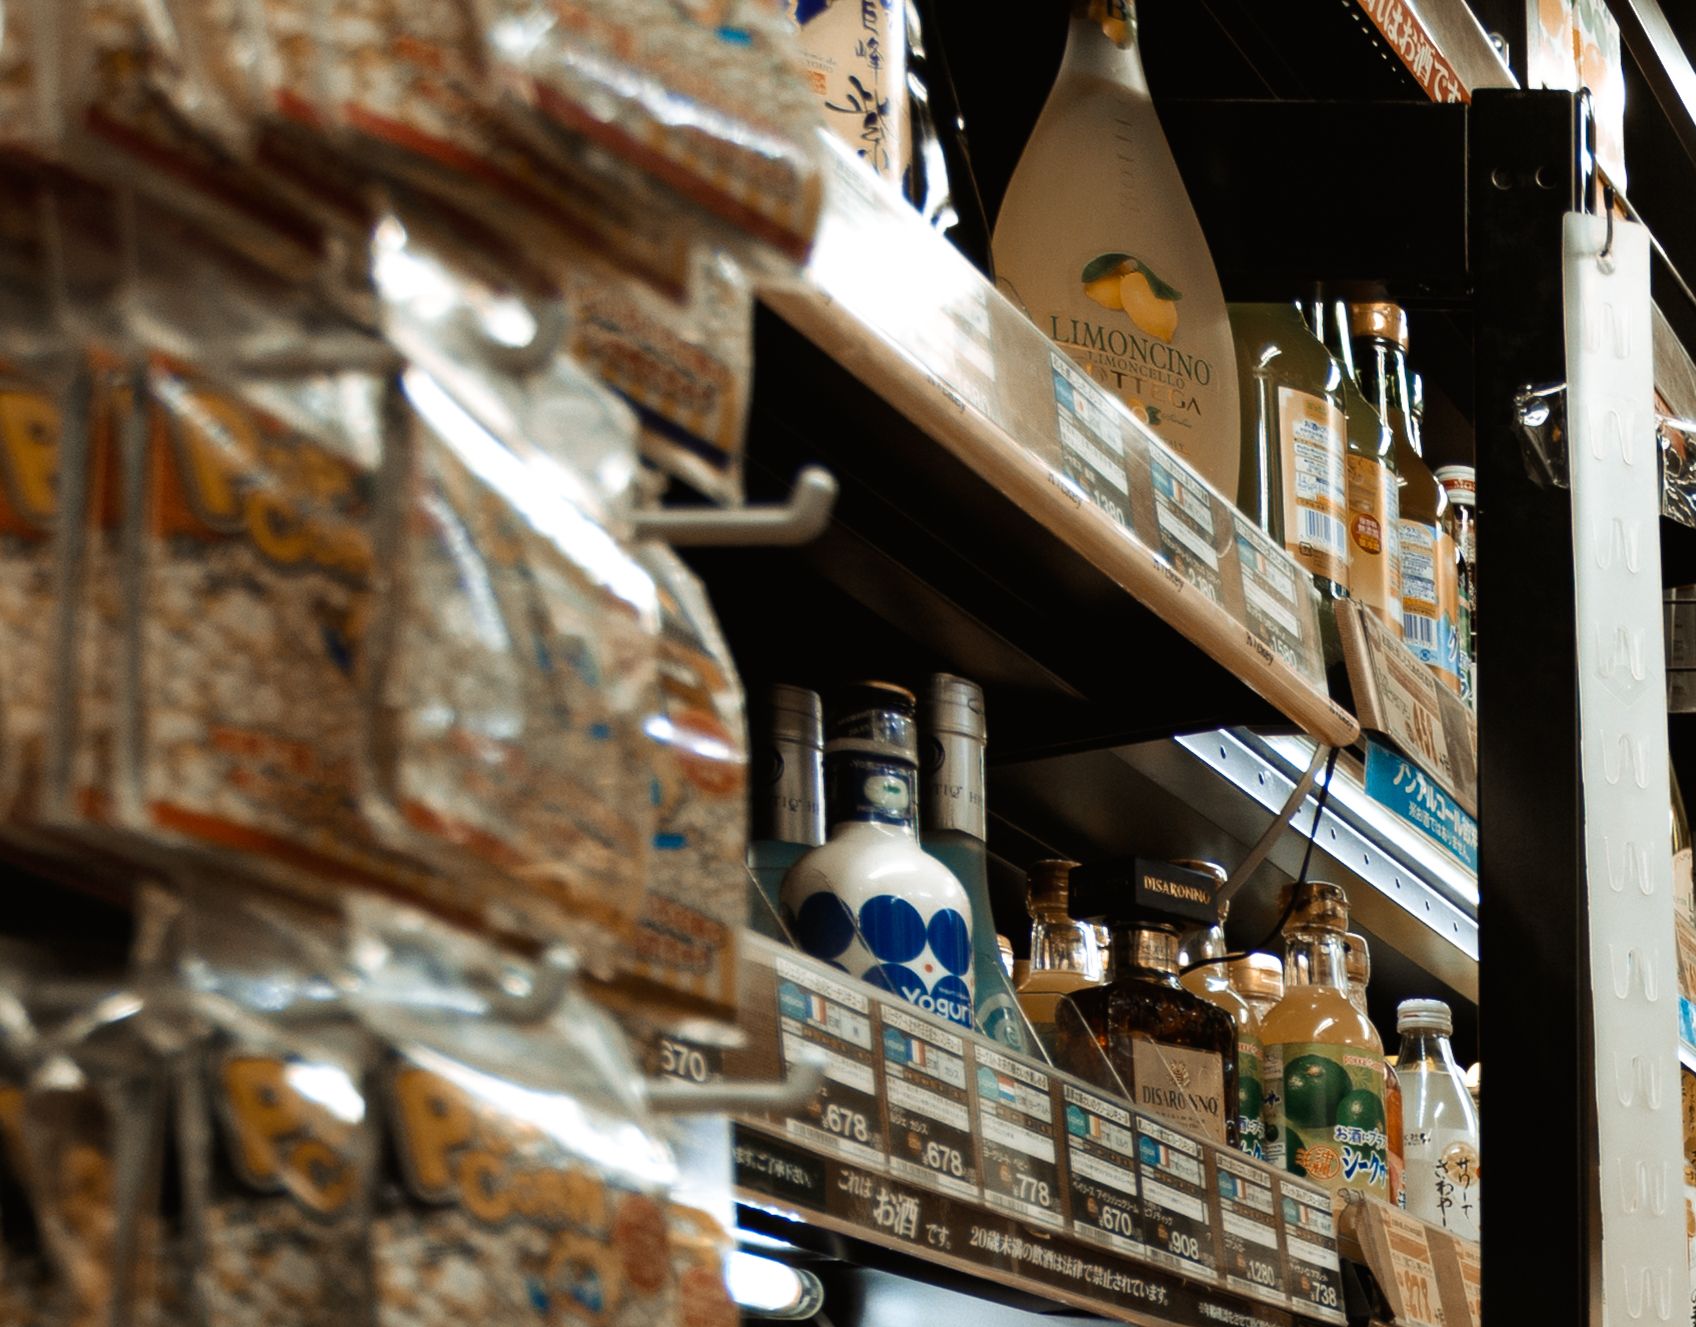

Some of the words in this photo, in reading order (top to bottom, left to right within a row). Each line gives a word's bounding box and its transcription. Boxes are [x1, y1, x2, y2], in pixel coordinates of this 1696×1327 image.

[1051, 315, 1211, 386] LIMONCINO
[1086, 351, 1185, 389] LIMONCELLO
[1143, 875, 1211, 906] DISARONNO
[1142, 1085, 1220, 1117] DISARONNO
[970, 1225, 1170, 1307] 20歳未満の飲酒は法律で禁止されています。
